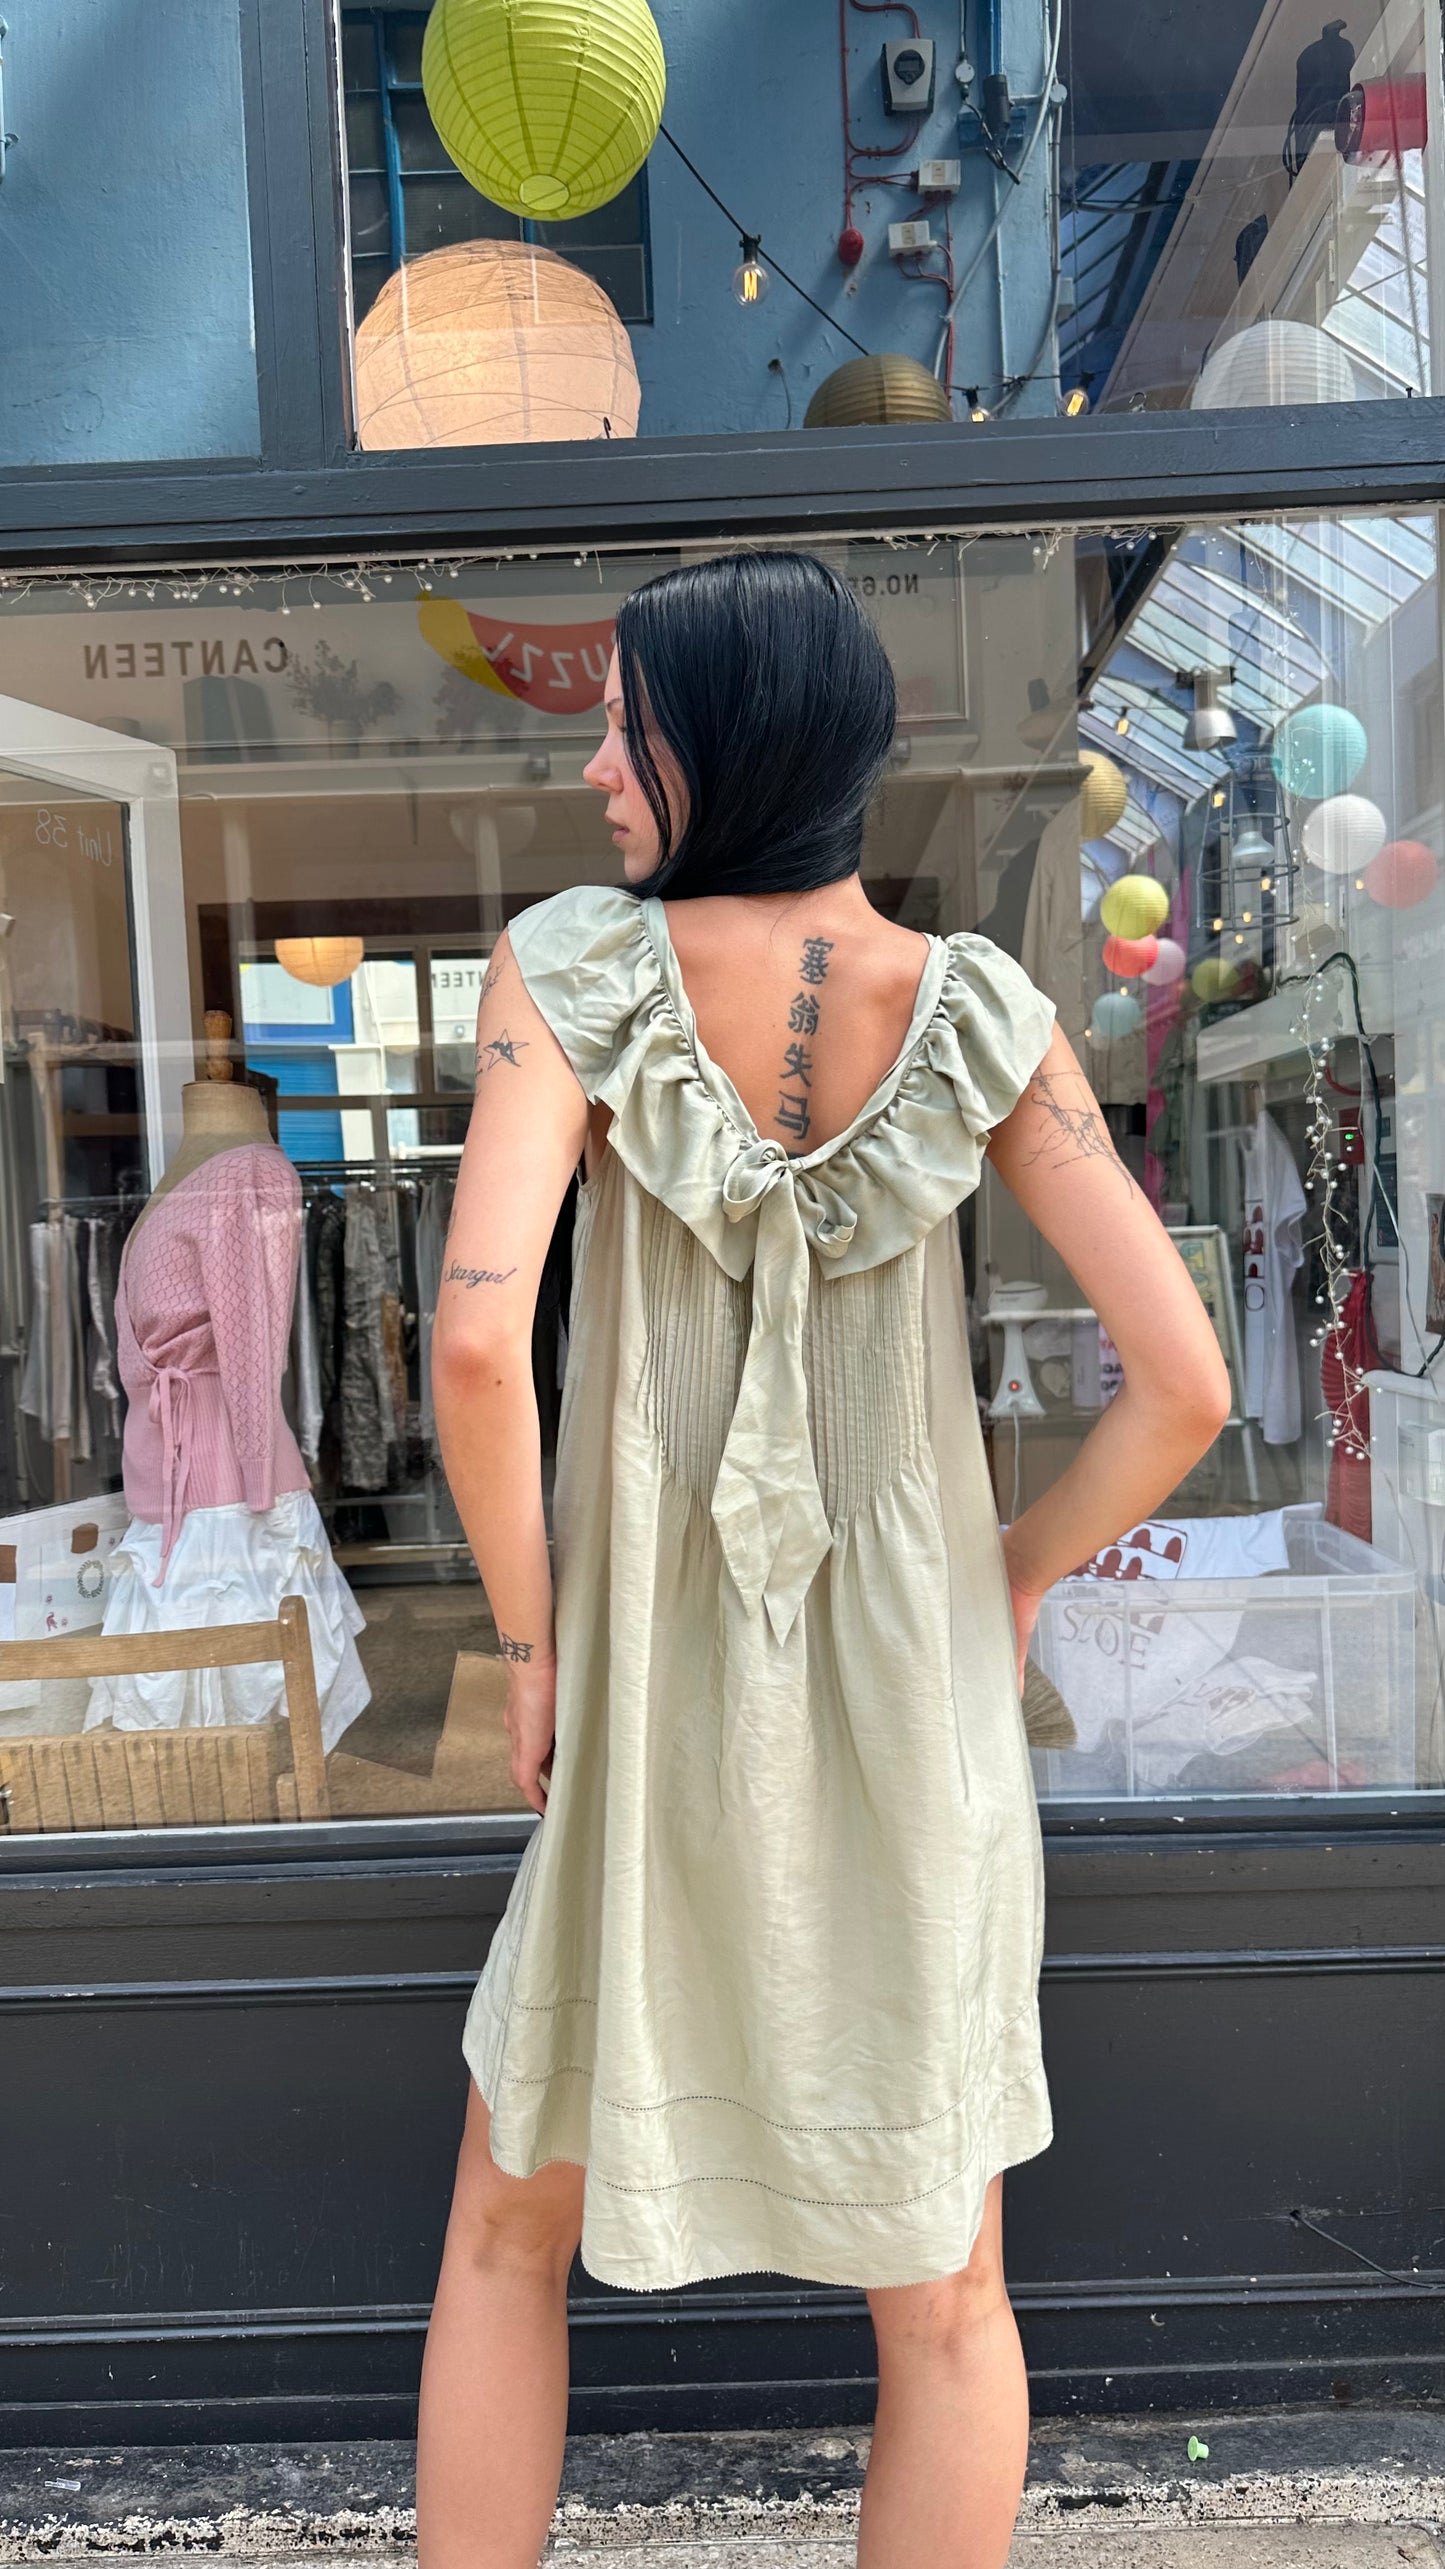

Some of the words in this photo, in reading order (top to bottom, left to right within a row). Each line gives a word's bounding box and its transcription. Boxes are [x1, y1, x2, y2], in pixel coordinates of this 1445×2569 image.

[773, 936, 835, 1140] 塞翁失马
[444, 1259, 517, 1289] Stargirl
